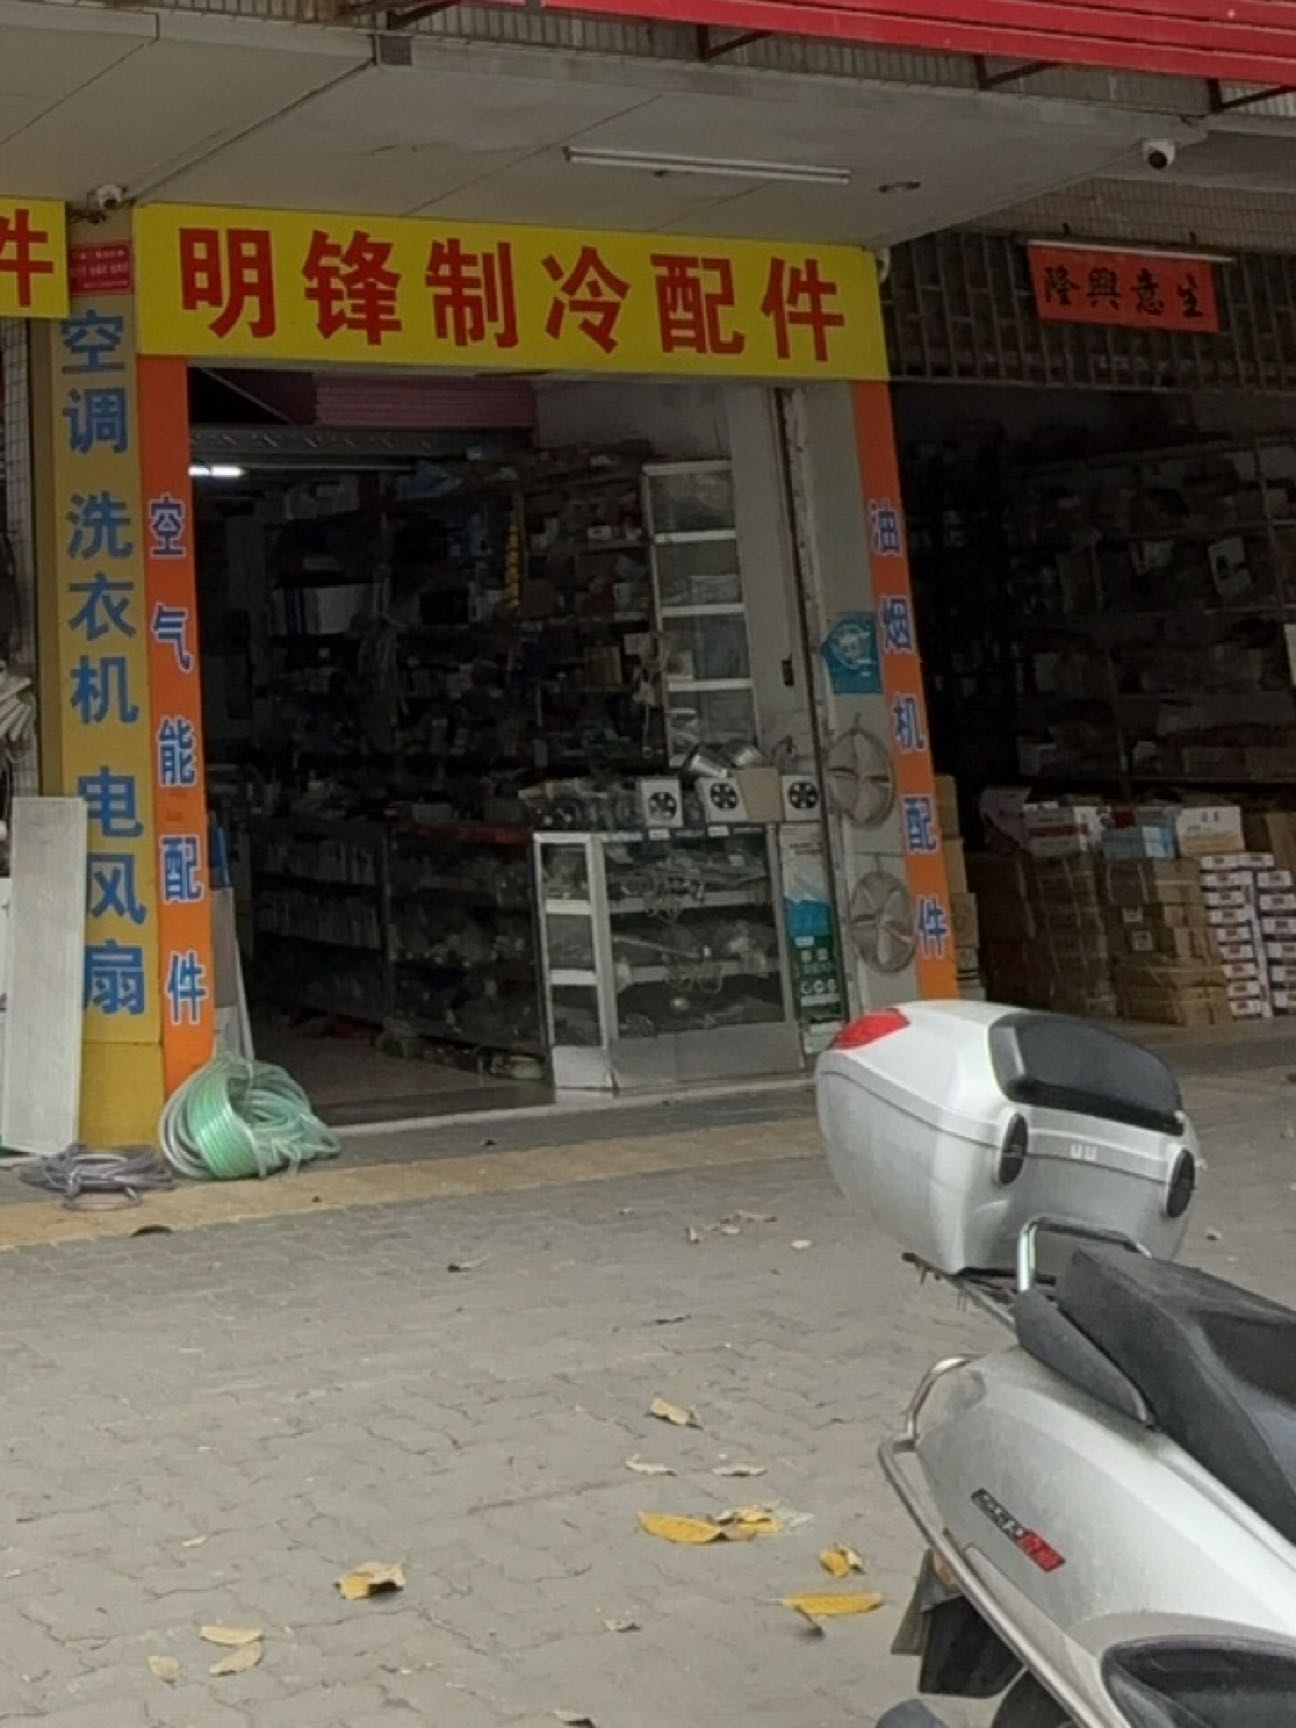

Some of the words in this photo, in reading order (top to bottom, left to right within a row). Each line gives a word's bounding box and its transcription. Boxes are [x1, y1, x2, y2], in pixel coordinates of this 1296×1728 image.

[60, 309, 130, 455] 空调
[179, 227, 846, 362] 明锋制冷配件
[65, 489, 140, 726] 洗衣机
[147, 490, 208, 1027] 空气能配件
[77, 765, 146, 1016] 电风扇
